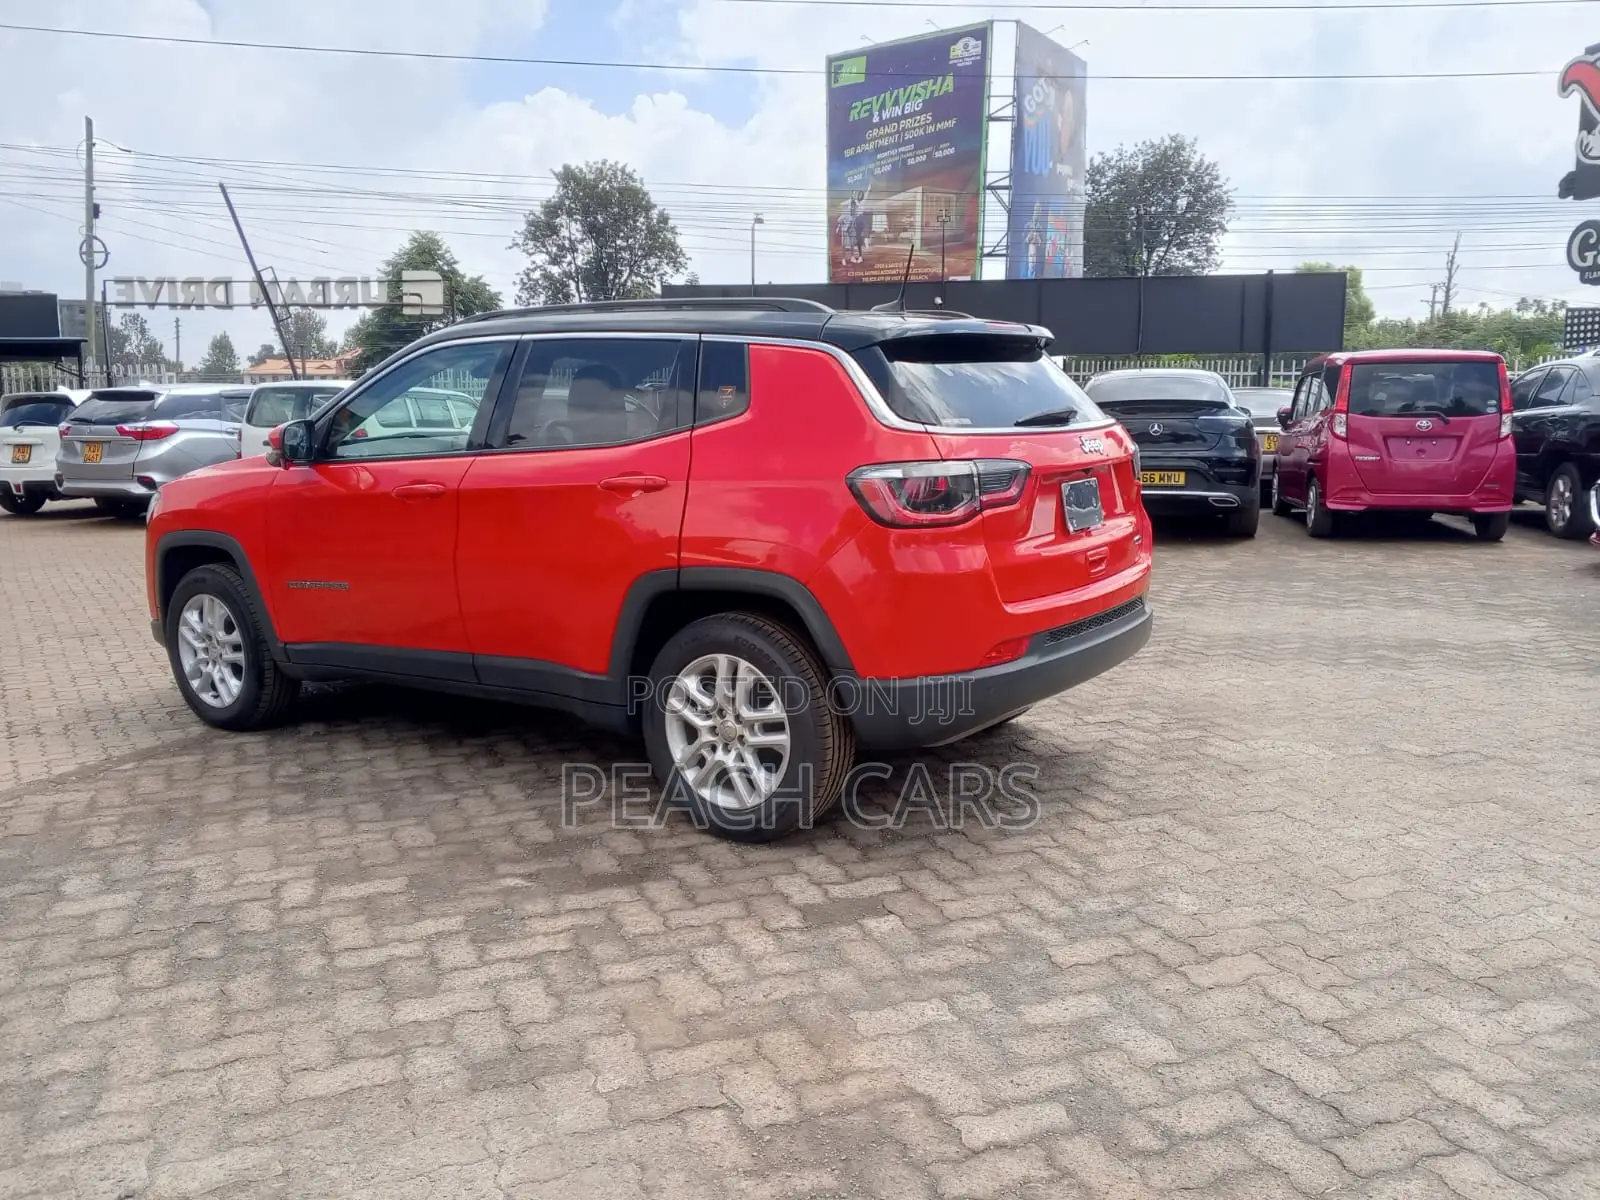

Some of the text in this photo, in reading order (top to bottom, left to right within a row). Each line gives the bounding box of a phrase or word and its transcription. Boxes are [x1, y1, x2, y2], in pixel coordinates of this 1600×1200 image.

[849, 75, 954, 121] REVVVISHA
[882, 104, 903, 120] WIN
[904, 99, 923, 114] BIG
[844, 147, 856, 158] 1BR
[856, 134, 899, 154] APARTMENT
[926, 123, 936, 134] IN
[937, 118, 958, 131] MMF
[866, 112, 932, 140] GRAND PRIZES
[1571, 228, 1600, 267] G
[1080, 436, 1104, 455] Jeep
[1159, 472, 1181, 484] MWU
